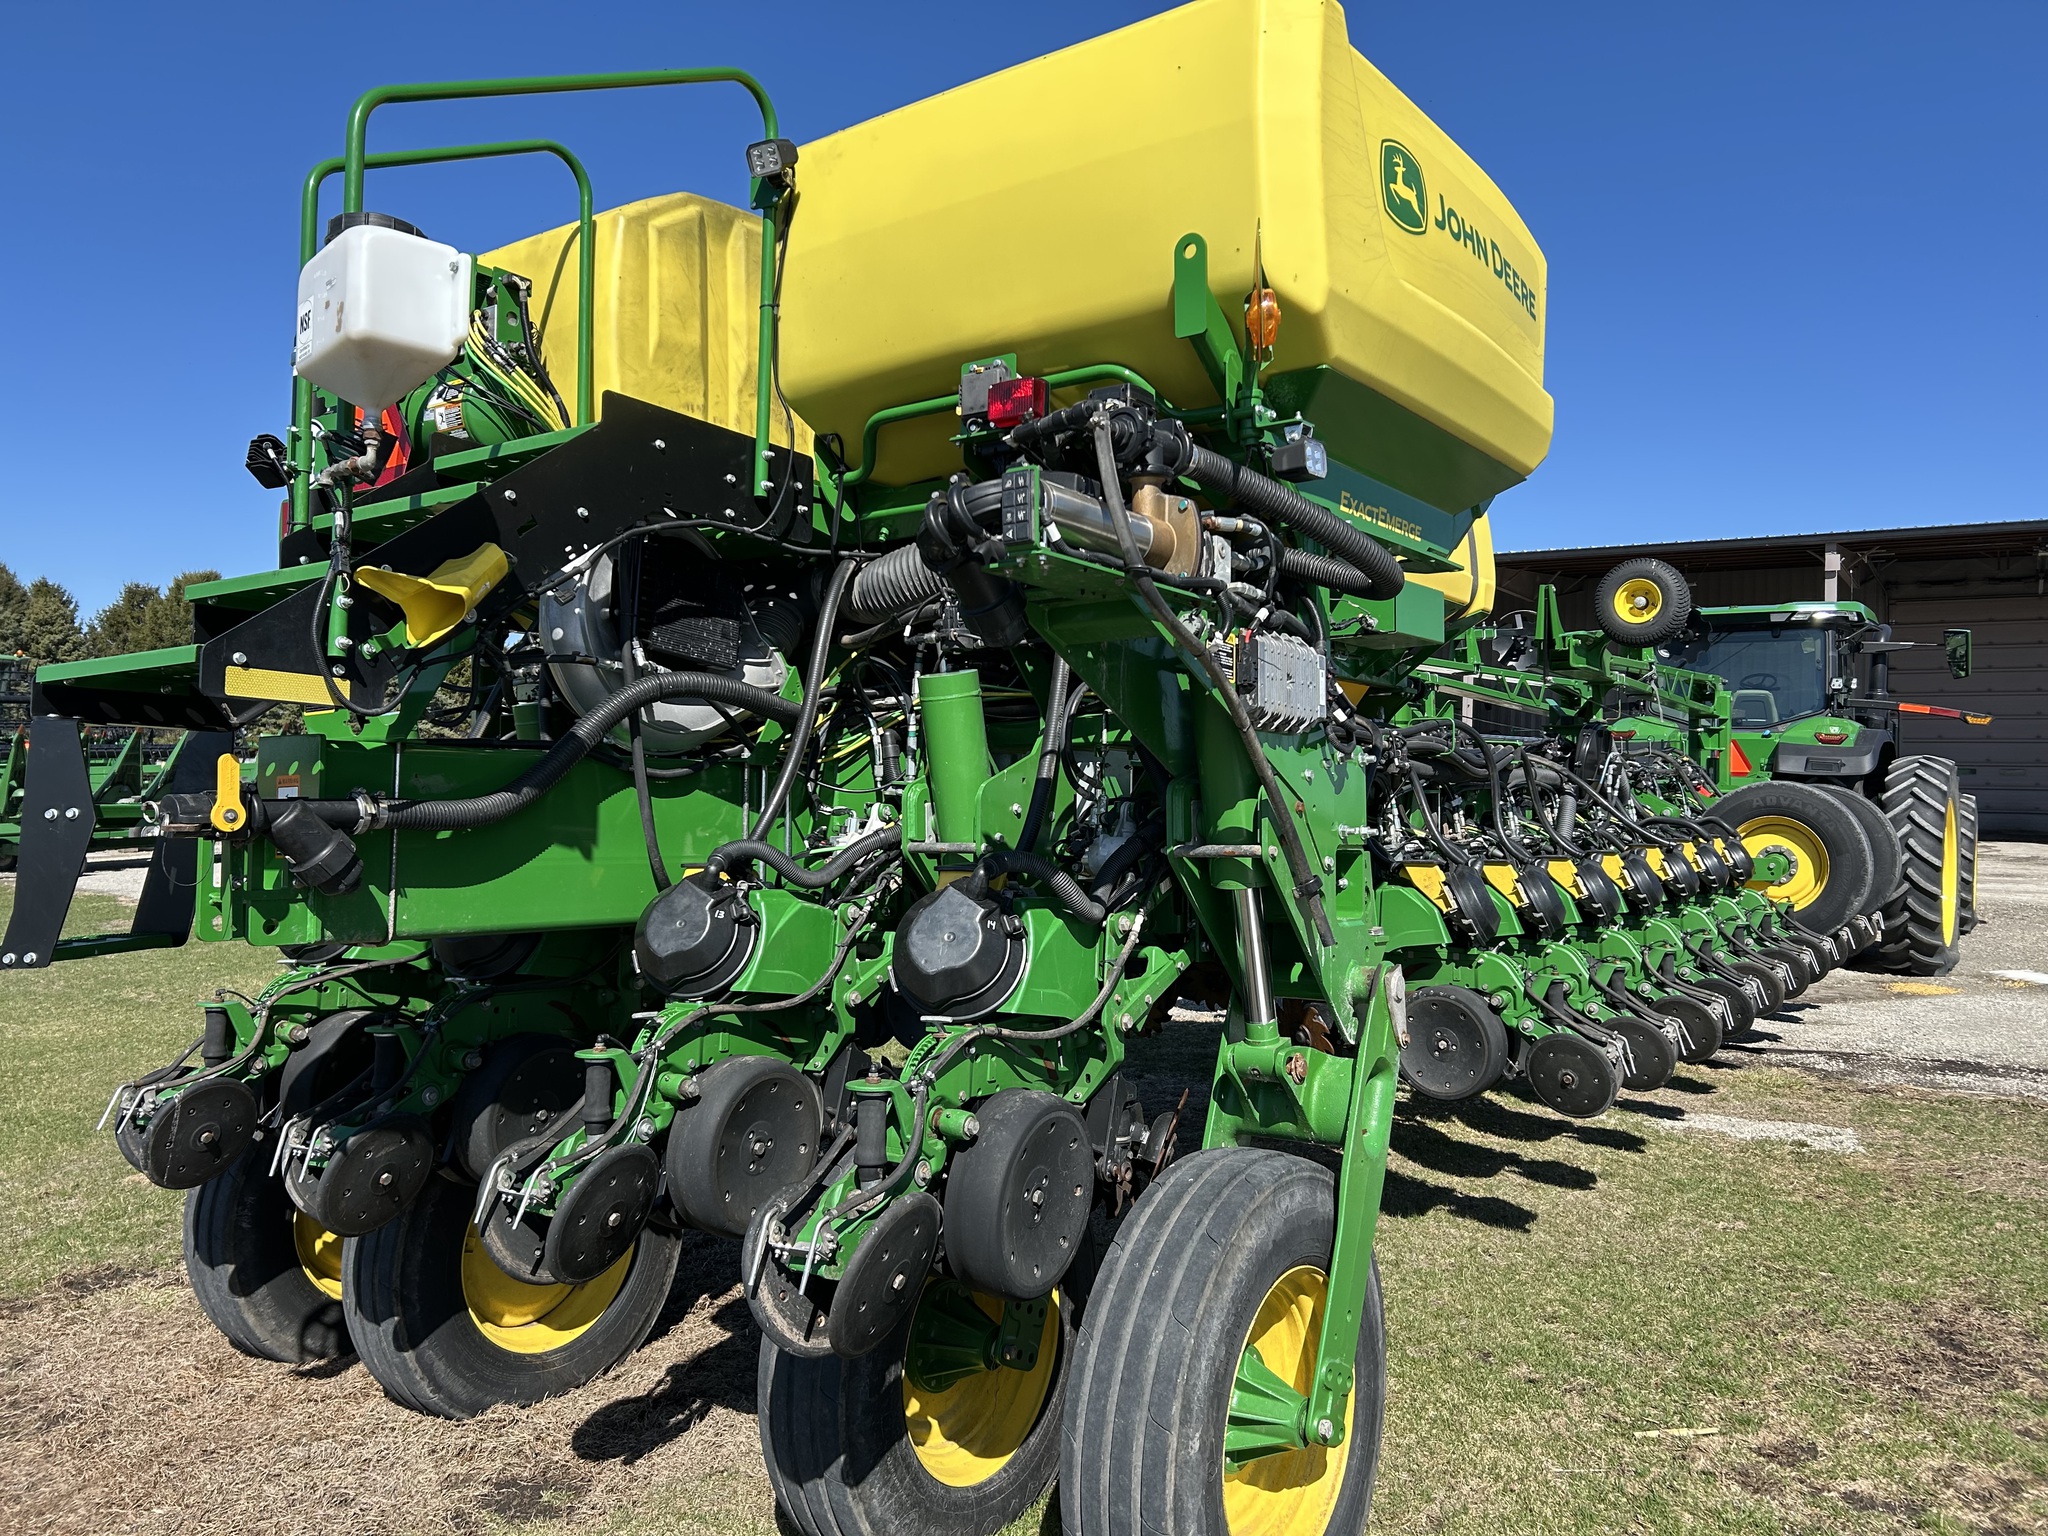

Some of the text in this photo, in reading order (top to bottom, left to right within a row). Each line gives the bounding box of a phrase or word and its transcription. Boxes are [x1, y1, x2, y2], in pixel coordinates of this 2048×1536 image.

[1434, 192, 1537, 322] JOHN DEERE
[300, 309, 311, 334] NSF
[714, 909, 726, 919] 13
[986, 919, 997, 930] 14
